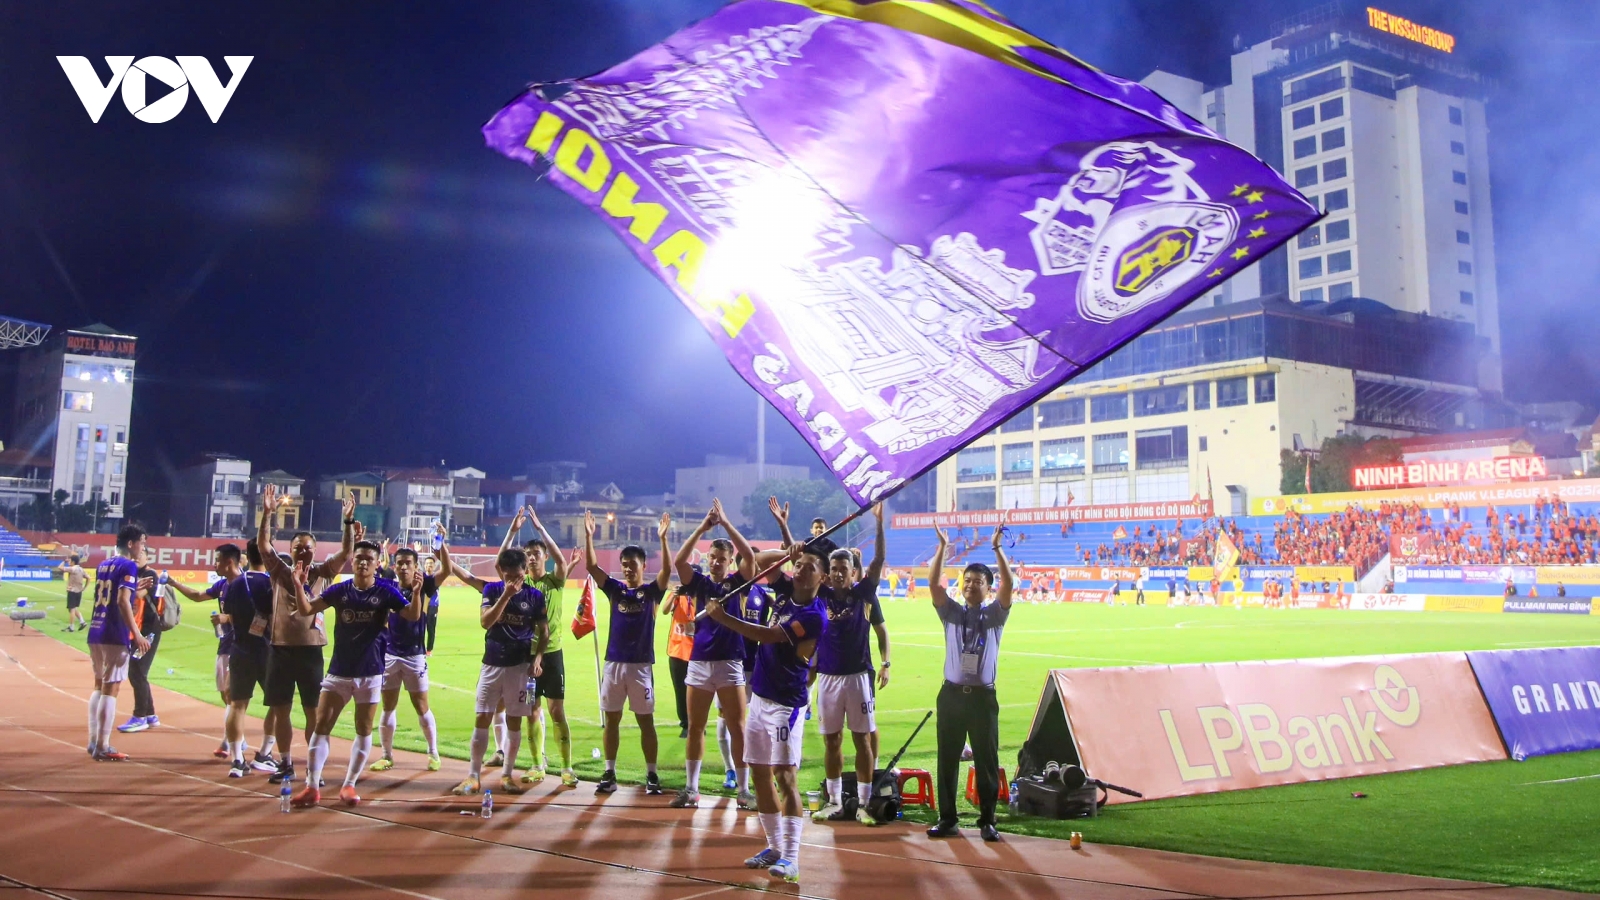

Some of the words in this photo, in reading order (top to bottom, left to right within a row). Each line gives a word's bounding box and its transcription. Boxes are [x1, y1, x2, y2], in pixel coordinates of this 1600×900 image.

[1366, 6, 1388, 32] THE
[1387, 13, 1422, 43] VISSAI
[1421, 26, 1455, 54] GROUP
[67, 336, 96, 350] HOTEL
[1354, 467, 1404, 487] NINH
[1407, 461, 1459, 484] BÌNH
[1463, 456, 1546, 481] ARENA
[1480, 486, 1540, 500] V.LEAGUE
[957, 513, 970, 524] TÌNH
[971, 512, 982, 523] YÊU
[983, 512, 998, 523] BÓNG
[1011, 511, 1032, 522] CHUNG
[1033, 511, 1044, 521] TAY
[1045, 509, 1059, 520] ỦNG
[1060, 508, 1069, 521] HỘ
[1071, 507, 1083, 520] HẾT
[1084, 507, 1103, 519] MÌNH
[1104, 507, 1118, 518] CHO
[1120, 505, 1132, 519] ĐỘI
[1134, 505, 1154, 517] BÓNG
[1156, 502, 1166, 516] CỐ
[1168, 503, 1178, 516] ĐÔ
[1180, 504, 1195, 516] HOA
[1067, 570, 1079, 578] FPT
[1080, 569, 1092, 580] Play
[1122, 569, 1136, 580] Play
[1379, 595, 1408, 606] VPF
[1503, 601, 1545, 610] PULLMAN
[1546, 602, 1568, 610] NINH
[1569, 601, 1591, 611] BÌNH
[1511, 680, 1600, 715] GRAND
[860, 701, 873, 715] 80
[775, 726, 789, 742] 10
[1158, 695, 1396, 783] LPBank
